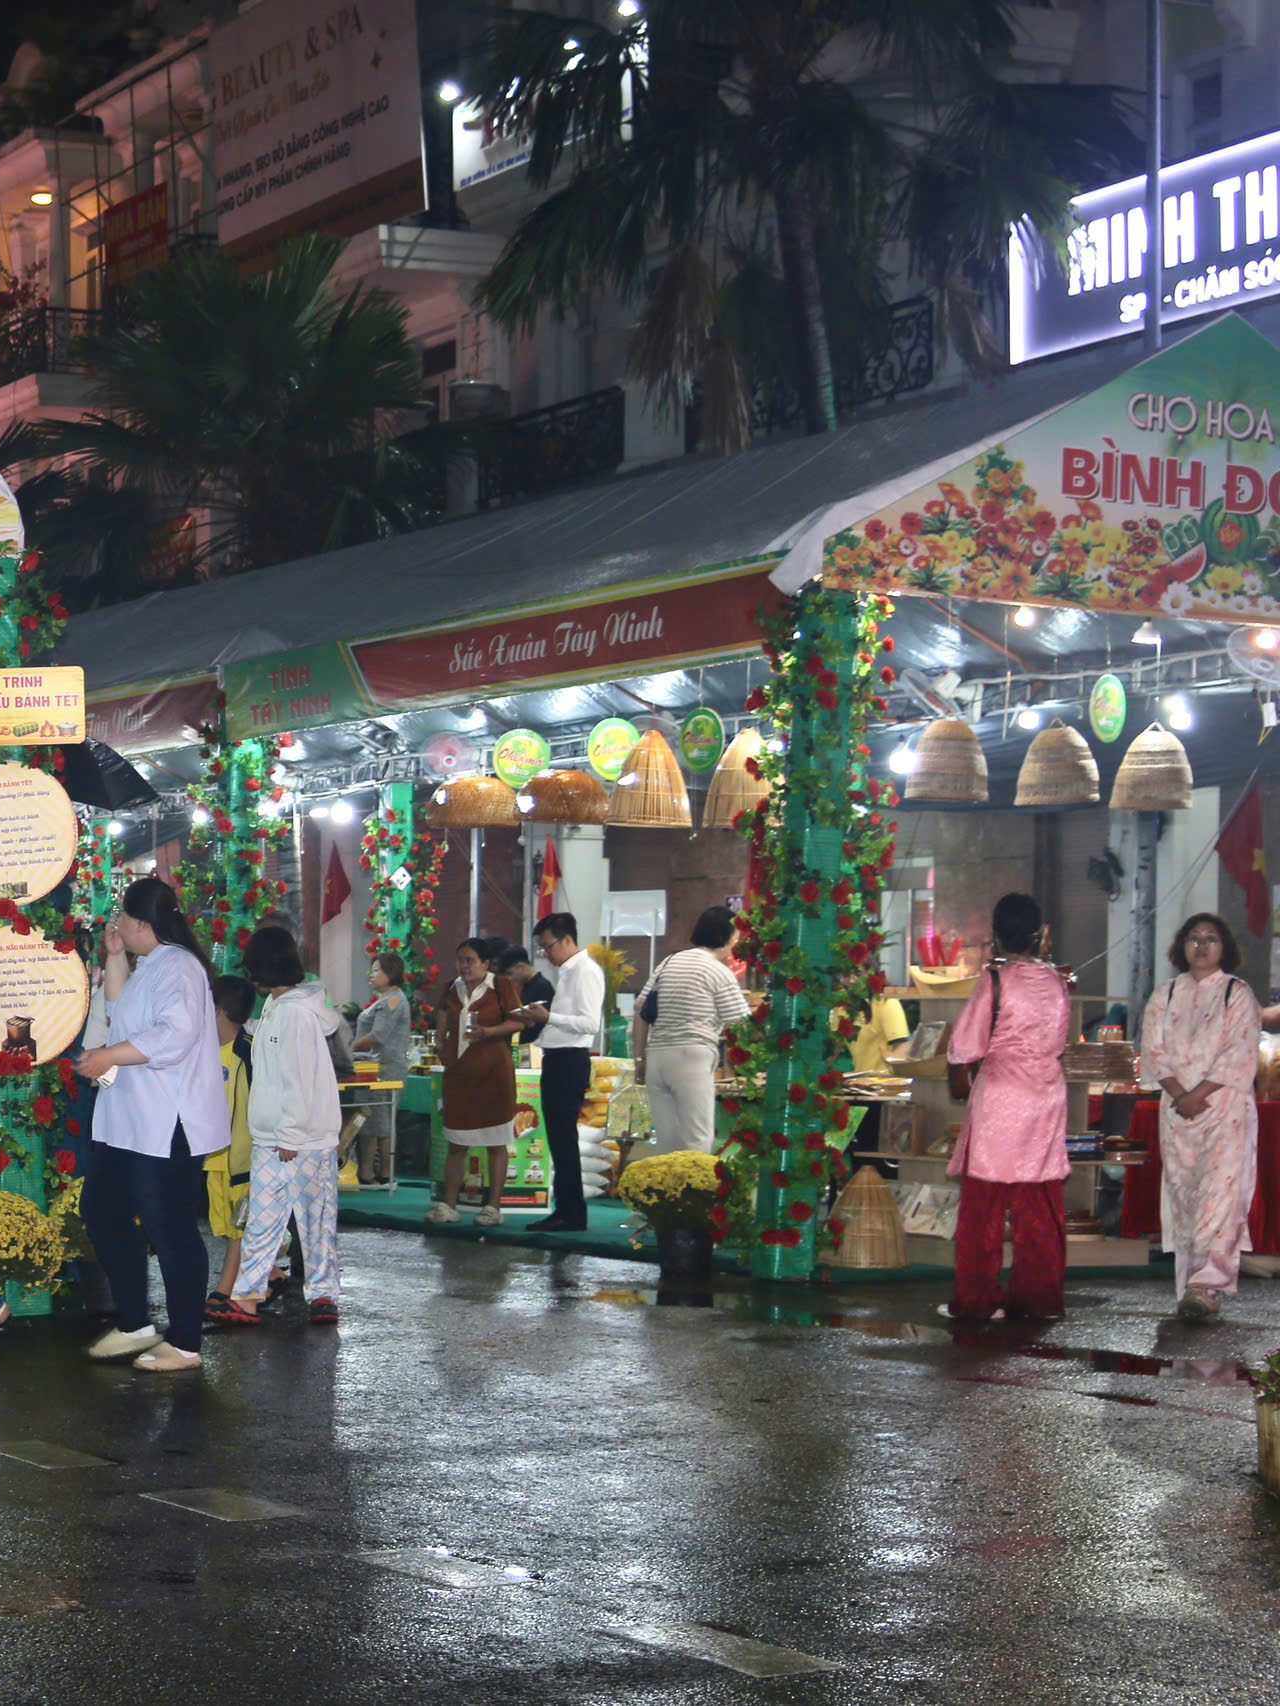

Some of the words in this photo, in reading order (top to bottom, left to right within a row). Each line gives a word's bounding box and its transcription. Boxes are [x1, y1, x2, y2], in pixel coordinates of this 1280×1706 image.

[221, 38, 297, 105] BEAUTY
[325, 5, 363, 50] SPA
[368, 94, 390, 117] CAO
[1175, 264, 1241, 309] CHĂM
[1127, 392, 1198, 441] CHỢ
[1206, 400, 1275, 444] HOA
[1061, 436, 1205, 512] BÌNH
[488, 632, 548, 668] Xuân
[553, 621, 598, 658] Tây
[604, 605, 664, 647] Ninh
[3, 673, 43, 689] TRÌNH
[14, 692, 51, 709] BÁNH
